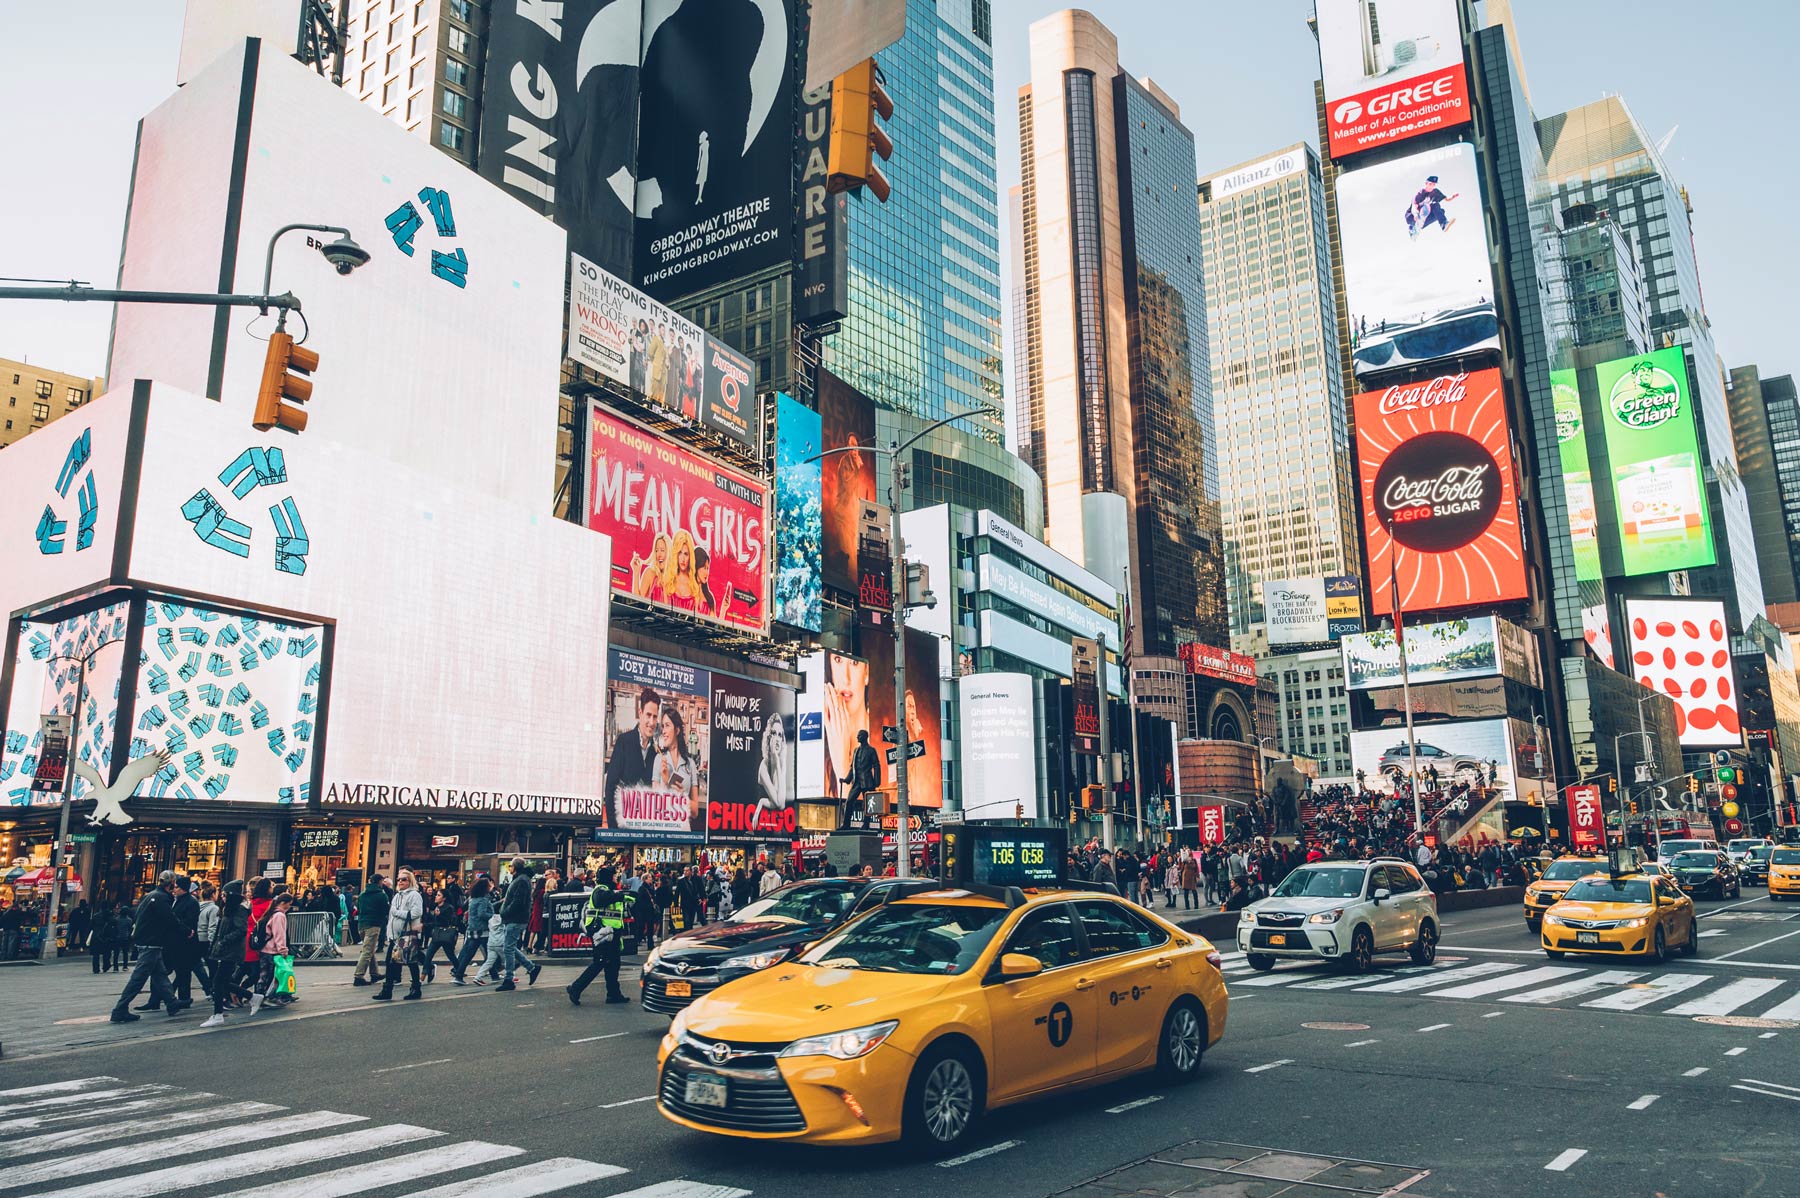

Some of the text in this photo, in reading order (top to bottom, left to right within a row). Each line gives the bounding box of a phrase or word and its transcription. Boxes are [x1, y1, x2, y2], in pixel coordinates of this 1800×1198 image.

[1367, 75, 1454, 116] GREE
[1334, 97, 1462, 140] Master of Air Conditioning
[1357, 115, 1442, 145] www.gree.com
[503, 61, 559, 222] ING
[802, 80, 830, 260] QUARE
[1223, 165, 1272, 192] Allianz
[661, 197, 771, 251] BROADWAY THEATRE
[661, 215, 759, 263] 53RD AND BROADWAY
[643, 228, 779, 286] KINGKONGBROADWAY.COM
[579, 261, 702, 342] SO WRONG IT'S RIGHT
[582, 281, 624, 311] THE PLAY
[804, 282, 826, 297] NYC
[576, 302, 628, 346] WRONG
[577, 290, 628, 328] THAT GOES
[712, 351, 749, 386] Avenue
[721, 373, 740, 413] Q
[1379, 373, 1470, 415] Coca-Cola
[1619, 391, 1677, 414] Green
[712, 413, 746, 436] AvenueQ.com
[1628, 404, 1681, 427] Giant
[593, 418, 616, 439] YOU
[619, 431, 652, 454] KNOW
[656, 446, 677, 466] YOU
[679, 457, 715, 483] WANNA
[716, 473, 728, 489] SIT
[729, 479, 750, 499] WITH
[1384, 464, 1489, 510] Coca-Cola
[593, 452, 761, 571] MEAN GIRLS
[1394, 500, 1480, 523] zero SUGAR
[990, 518, 1024, 548] General News
[859, 587, 891, 608] RISE
[860, 573, 889, 594] ALL
[1277, 608, 1313, 616] BROADWAY
[1330, 623, 1360, 633] FROZEN
[619, 659, 694, 685] JOEY McINTYRE
[634, 676, 654, 684] THROUGH
[1351, 660, 1400, 675] Hyunda
[715, 689, 762, 712] IT WOULD BE
[970, 692, 992, 700] General
[715, 712, 762, 732] CRIMINAL TO
[1074, 717, 1100, 733] RISE
[1075, 703, 1097, 720] ALL
[726, 733, 754, 752] MISS IT
[37, 766, 65, 778] RISE
[41, 758, 63, 769] ALL
[326, 782, 602, 816] AMERICAN EAGLE OUTFITTERS
[622, 789, 688, 822] WAITRESS
[1574, 789, 1595, 827] tkts
[708, 801, 796, 833] CHICAGO
[1204, 809, 1217, 841] tkts
[645, 848, 681, 862] GRAND
[992, 849, 1014, 864] 1:05
[1022, 848, 1043, 864] 0:58
[1054, 1010, 1066, 1040] T
